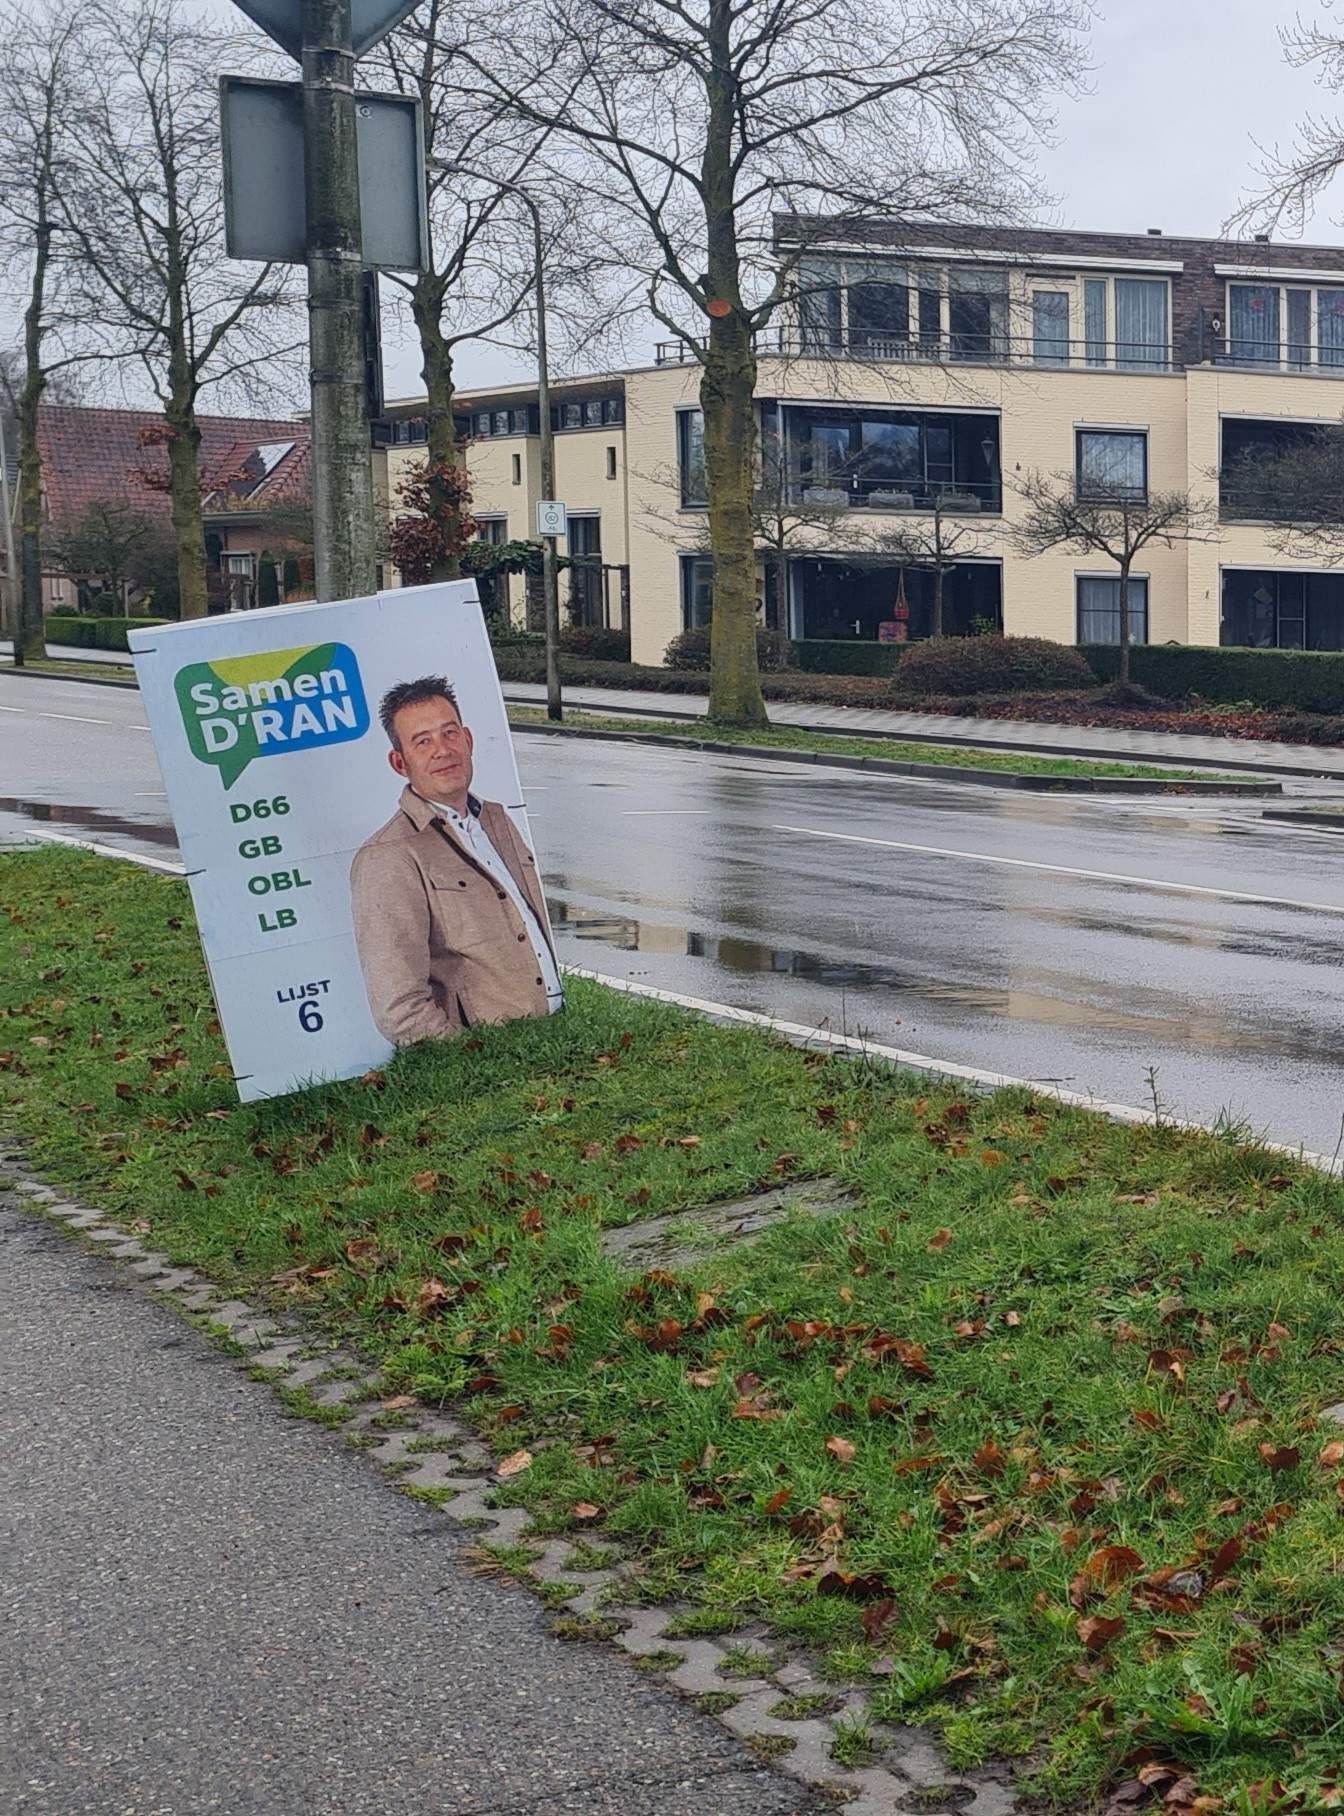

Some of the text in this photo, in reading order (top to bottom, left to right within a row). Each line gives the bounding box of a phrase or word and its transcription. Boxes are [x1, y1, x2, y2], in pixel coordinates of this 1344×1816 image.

[190, 667, 348, 716] Samen
[200, 695, 358, 754] D'RAN
[229, 795, 291, 824] D66
[238, 835, 283, 859] GB
[247, 868, 312, 896] OBL
[257, 908, 298, 933] LB
[276, 979, 331, 1004] LIJST
[298, 1001, 324, 1033] 6
